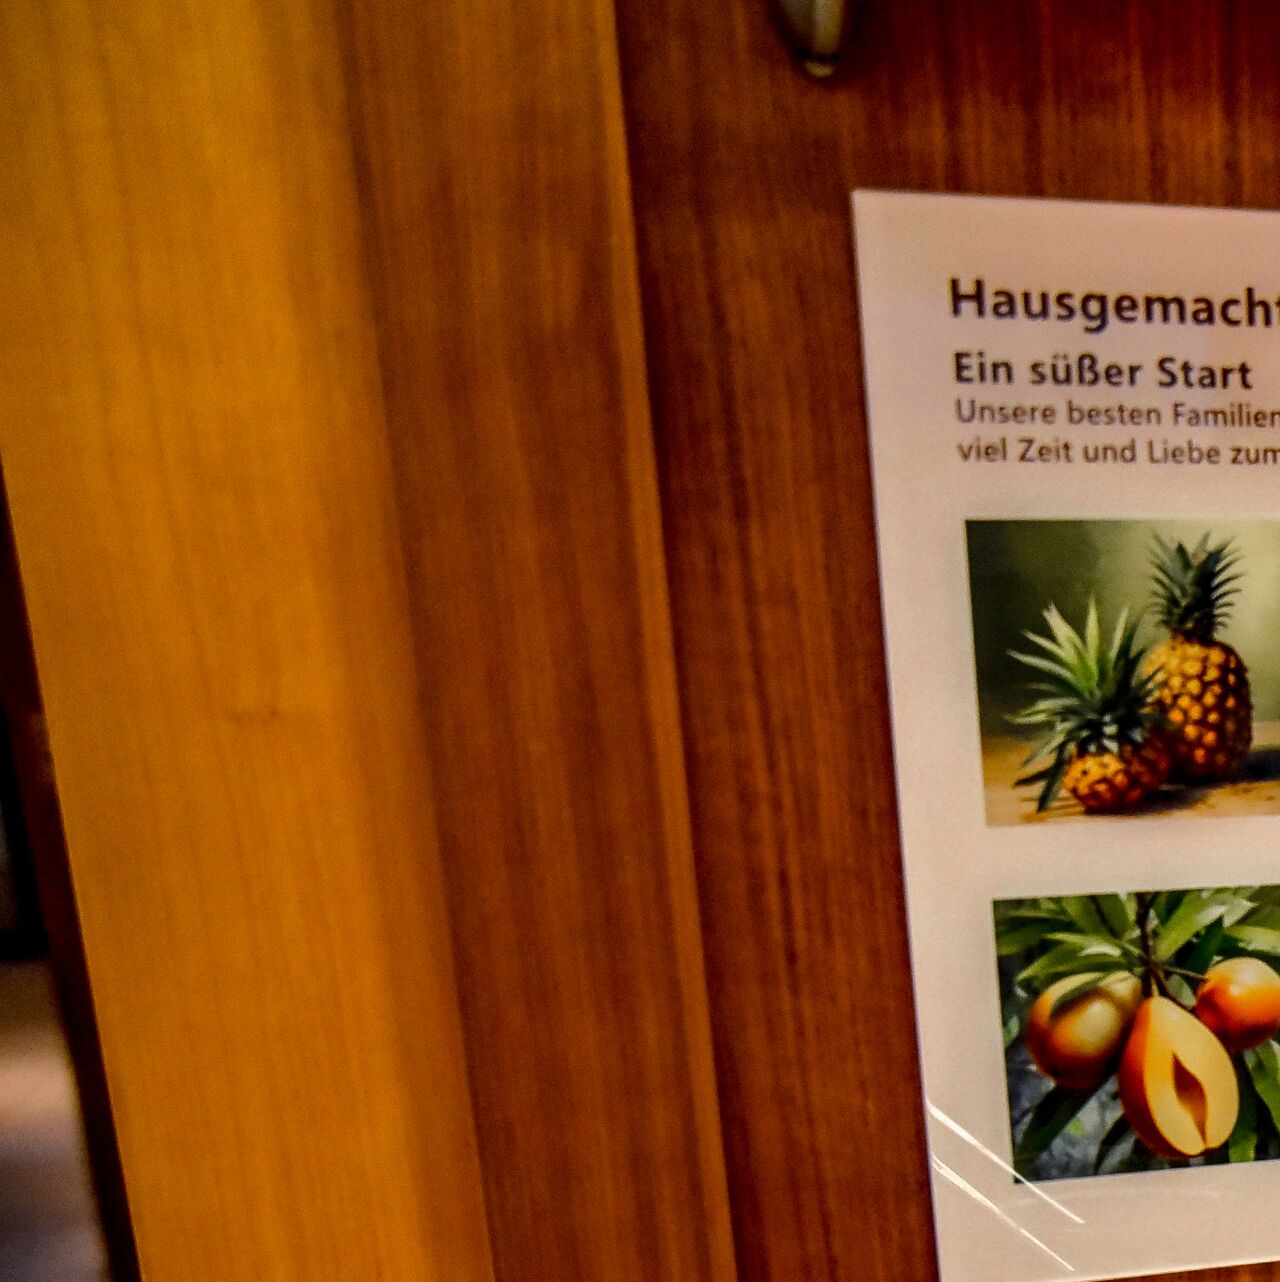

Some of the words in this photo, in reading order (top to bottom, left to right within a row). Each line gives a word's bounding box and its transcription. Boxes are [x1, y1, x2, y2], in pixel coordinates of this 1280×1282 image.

[953, 351, 1014, 385] Ein
[1029, 352, 1143, 388] süßer
[1157, 356, 1253, 391] Start
[954, 397, 1057, 426] Unsere
[1066, 399, 1162, 426] besten
[956, 436, 1008, 463] viel
[1018, 436, 1073, 464] Zeit
[1082, 438, 1138, 464] und
[1147, 438, 1222, 466] Liebe
